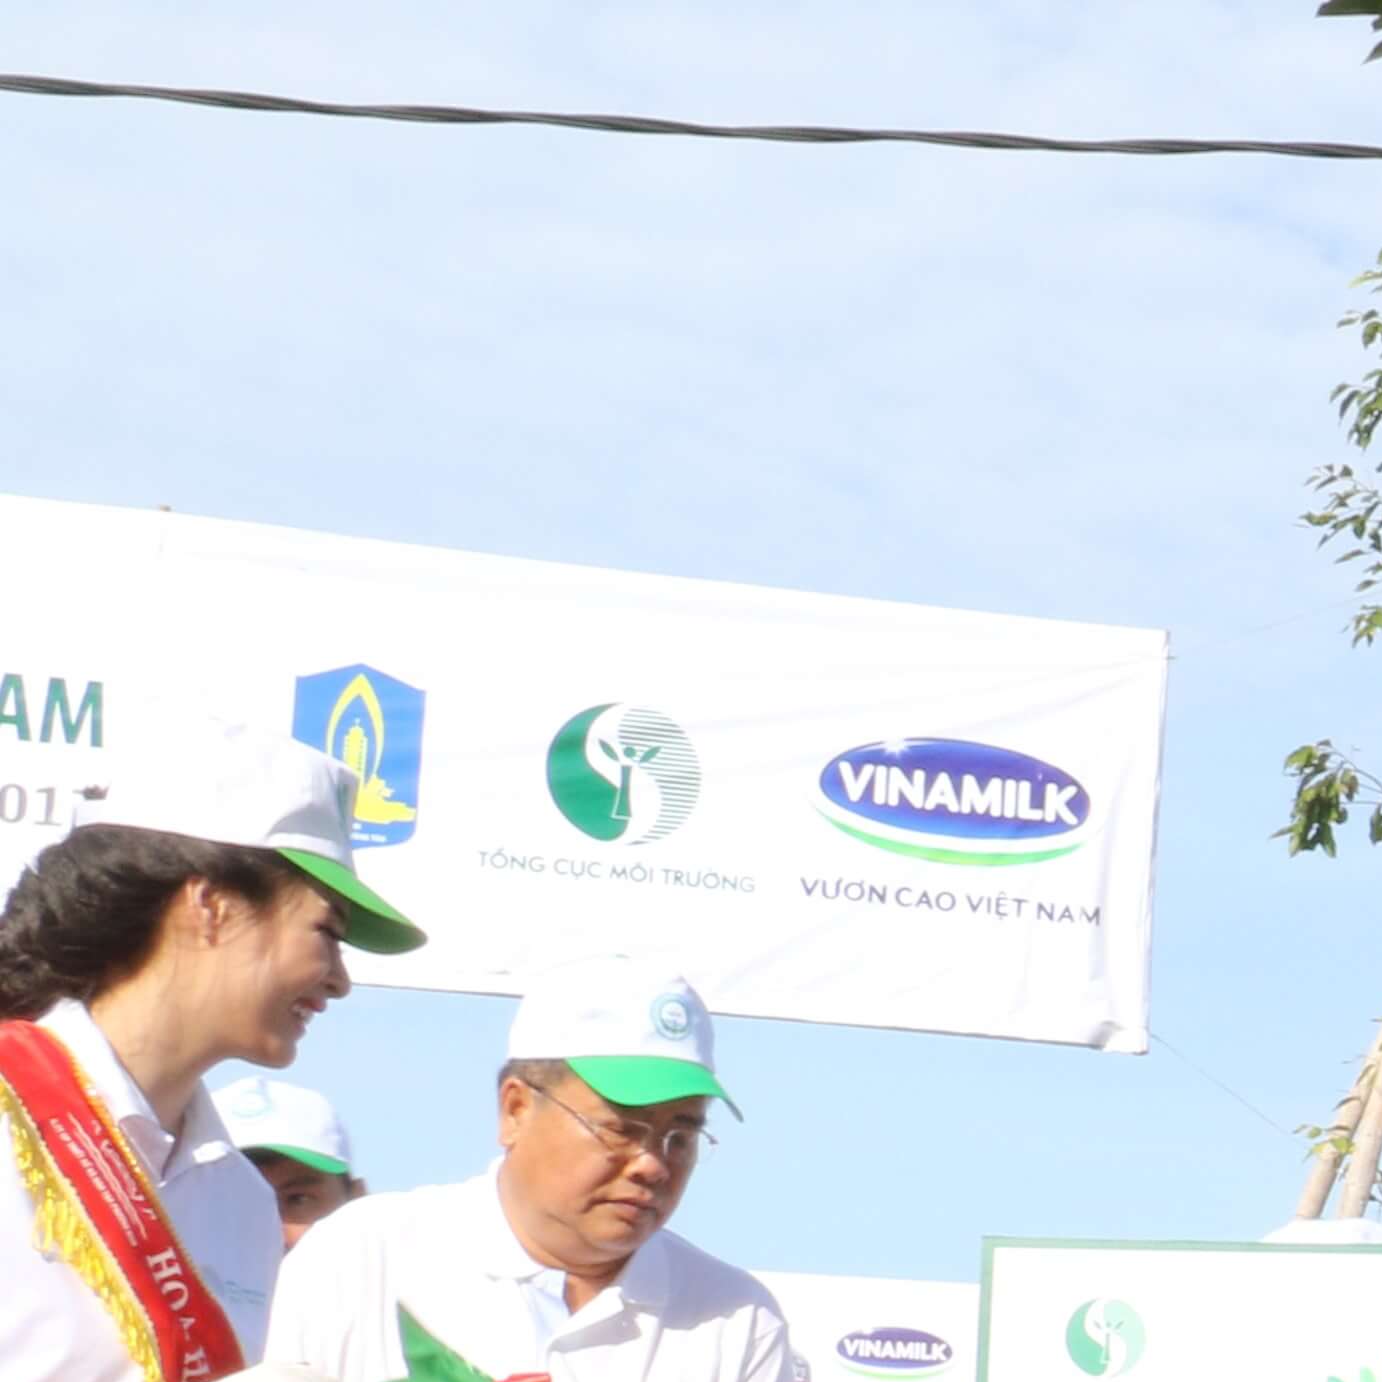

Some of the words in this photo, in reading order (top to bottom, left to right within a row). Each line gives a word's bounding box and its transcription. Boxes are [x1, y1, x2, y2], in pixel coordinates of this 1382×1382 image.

[838, 761, 1079, 825] VINAMILK
[553, 858, 603, 881] CỤC
[894, 886, 957, 912] CAO
[966, 891, 1029, 921] VIỆT
[1036, 901, 1102, 928] NAM
[843, 1339, 947, 1361] VINAMILK
